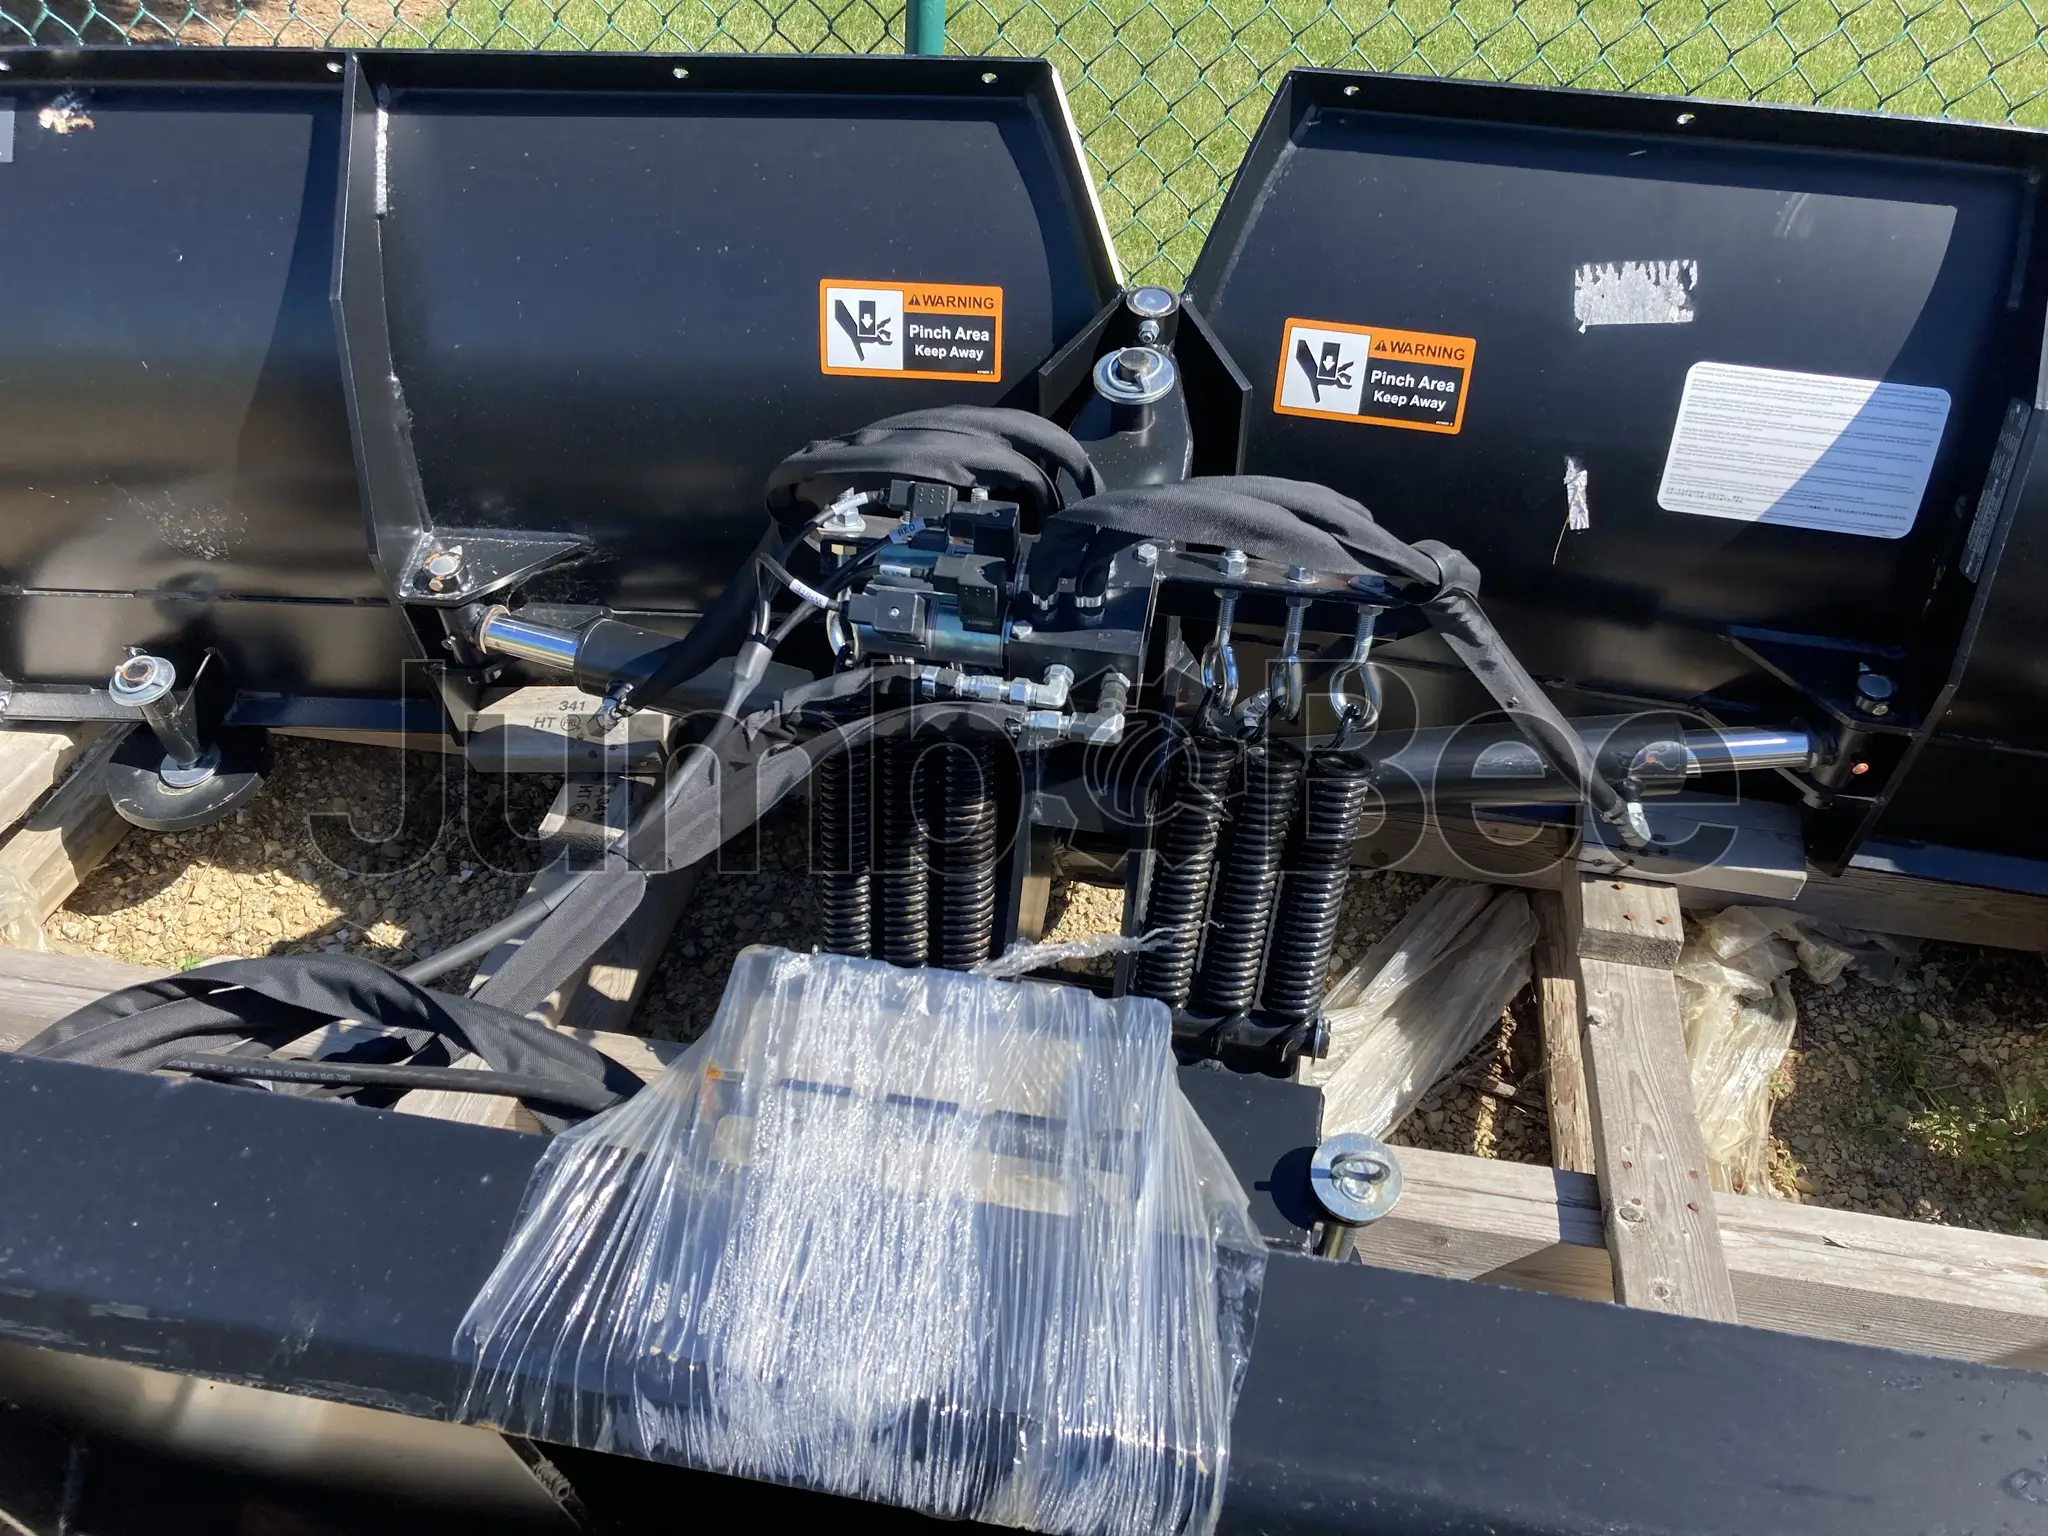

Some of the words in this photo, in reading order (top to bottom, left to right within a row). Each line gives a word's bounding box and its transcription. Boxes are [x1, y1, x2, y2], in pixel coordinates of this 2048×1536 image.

[922, 294, 994, 309] WARNING
[909, 324, 951, 340] Pinch
[954, 326, 990, 342] Area
[914, 344, 947, 360] Keep
[949, 346, 984, 362] Away
[1390, 340, 1465, 361] WARNING
[1370, 369, 1415, 388] Pinch
[1417, 375, 1455, 393] Area
[1373, 389, 1407, 407] Keep
[1409, 394, 1447, 412] Away
[897, 523, 916, 537] RED
[558, 700, 586, 712] 341
[533, 716, 556, 729] HT
